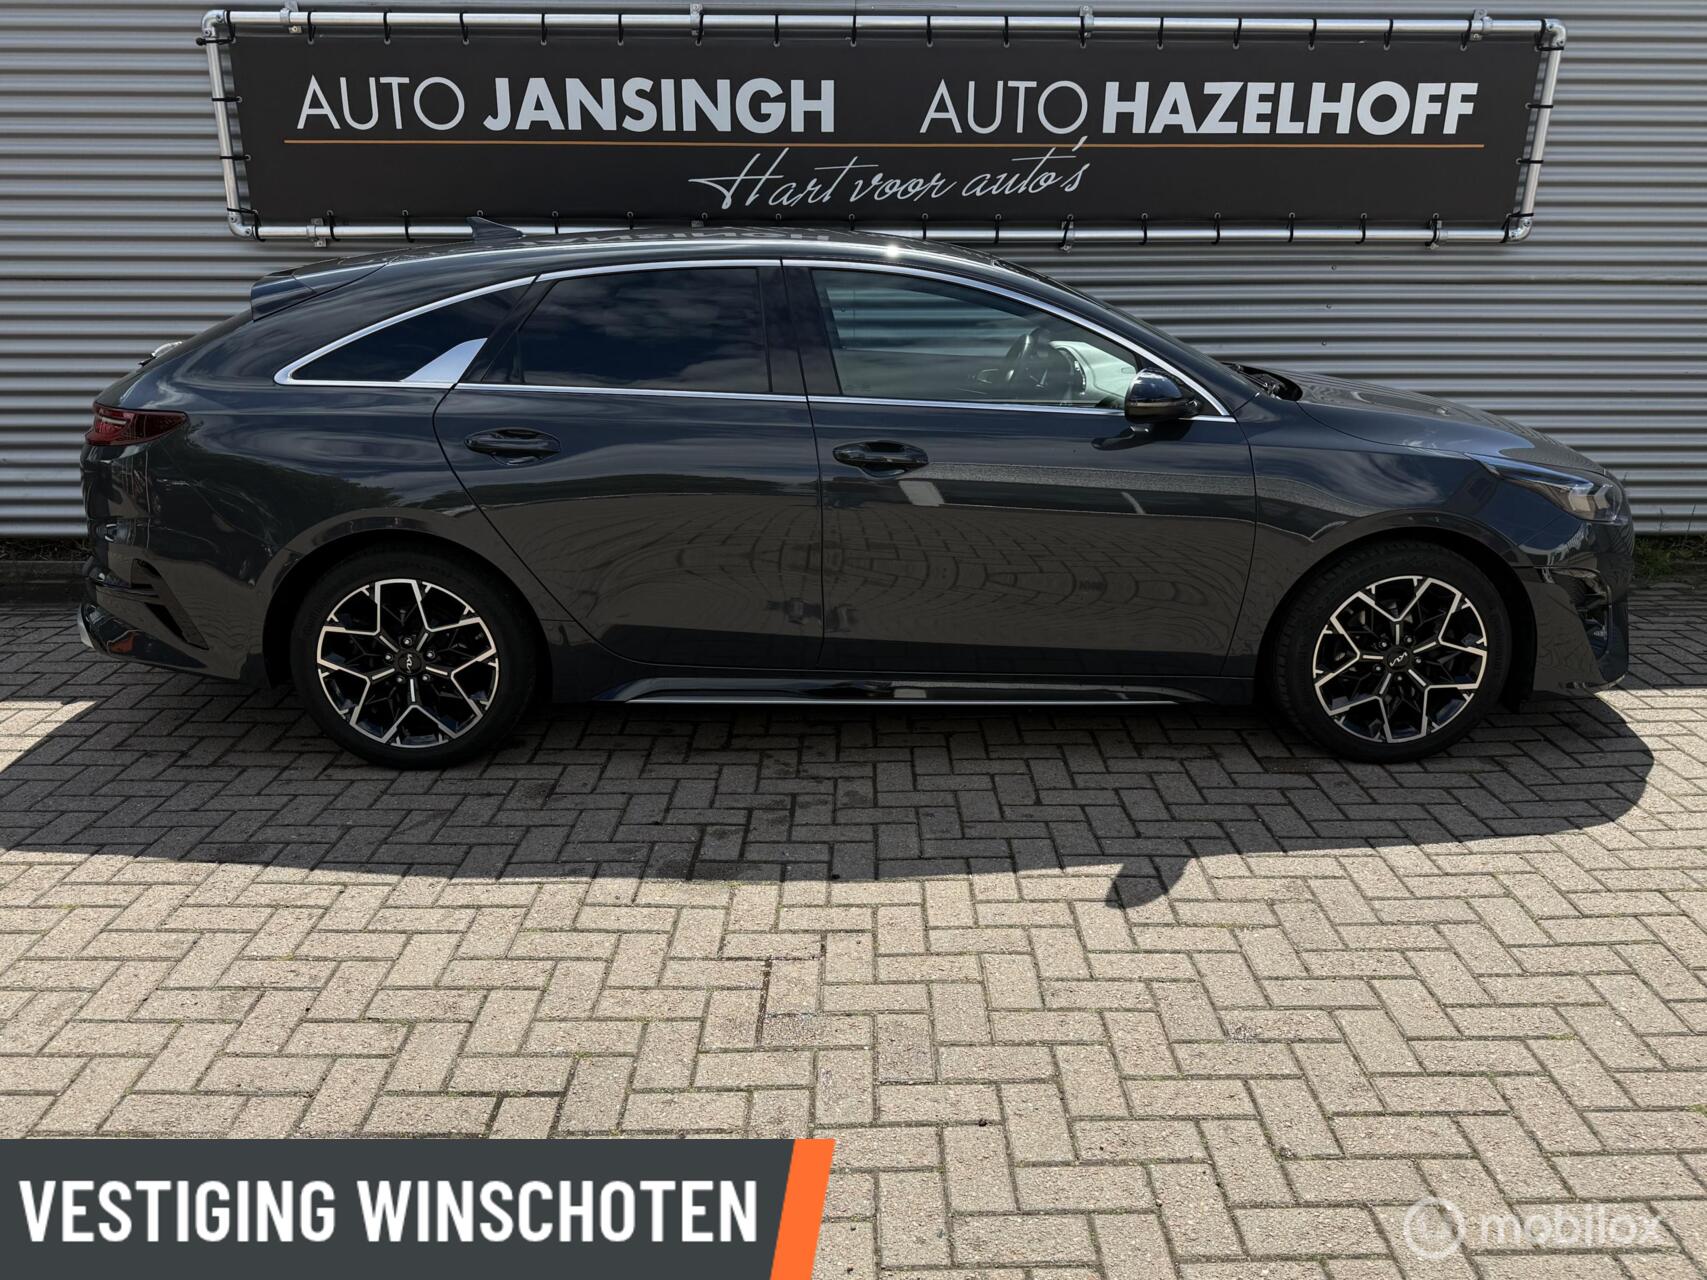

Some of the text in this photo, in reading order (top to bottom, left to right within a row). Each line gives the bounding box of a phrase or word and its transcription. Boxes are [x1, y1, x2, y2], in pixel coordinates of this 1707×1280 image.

[296, 74, 835, 134] AUTO JANSINGH
[919, 79, 1479, 136] AUTO HAZELHOFF
[688, 137, 1091, 209] Hart voor auto's
